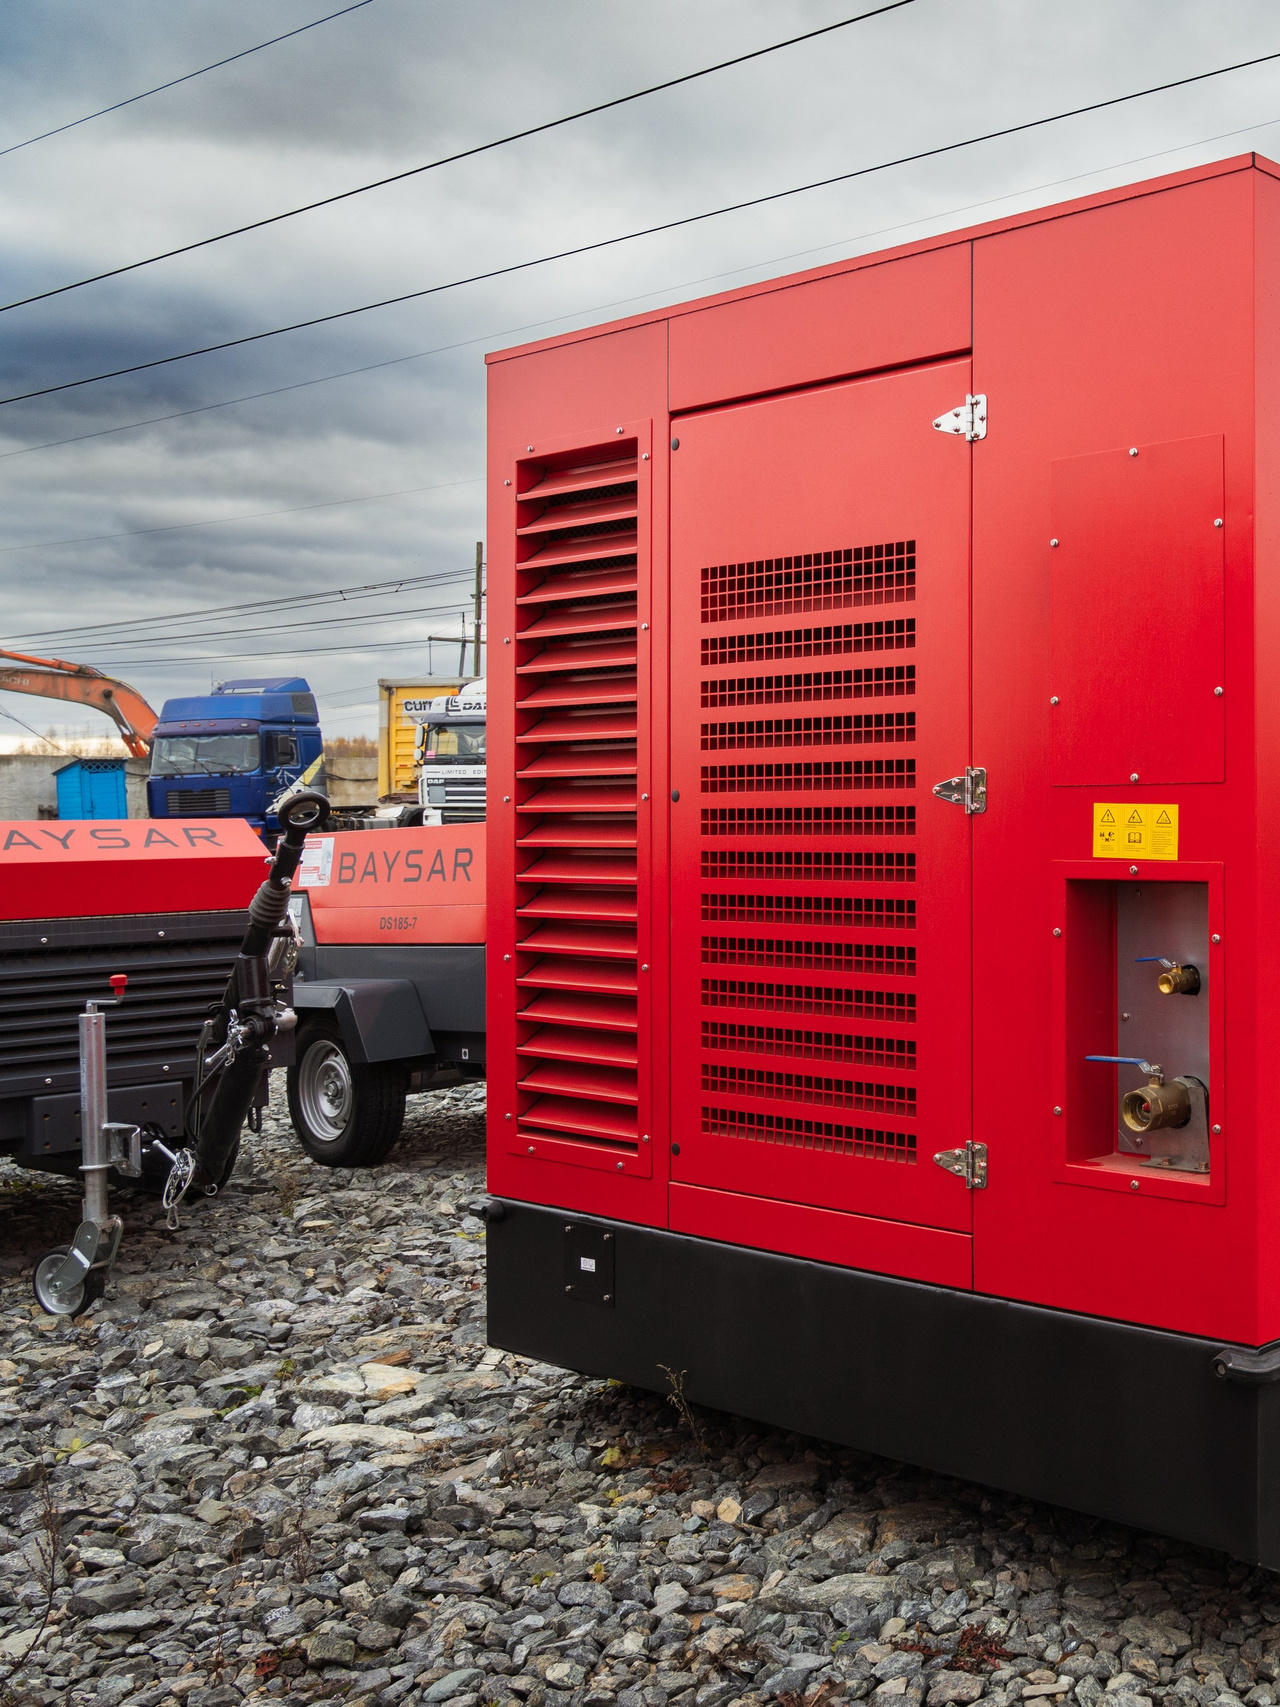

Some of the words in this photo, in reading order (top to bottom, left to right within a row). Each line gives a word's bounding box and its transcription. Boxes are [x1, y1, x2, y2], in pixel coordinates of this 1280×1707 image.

[462, 702, 487, 711] DA
[338, 848, 473, 884] BAYSAR
[379, 916, 418, 930] DS185-7
